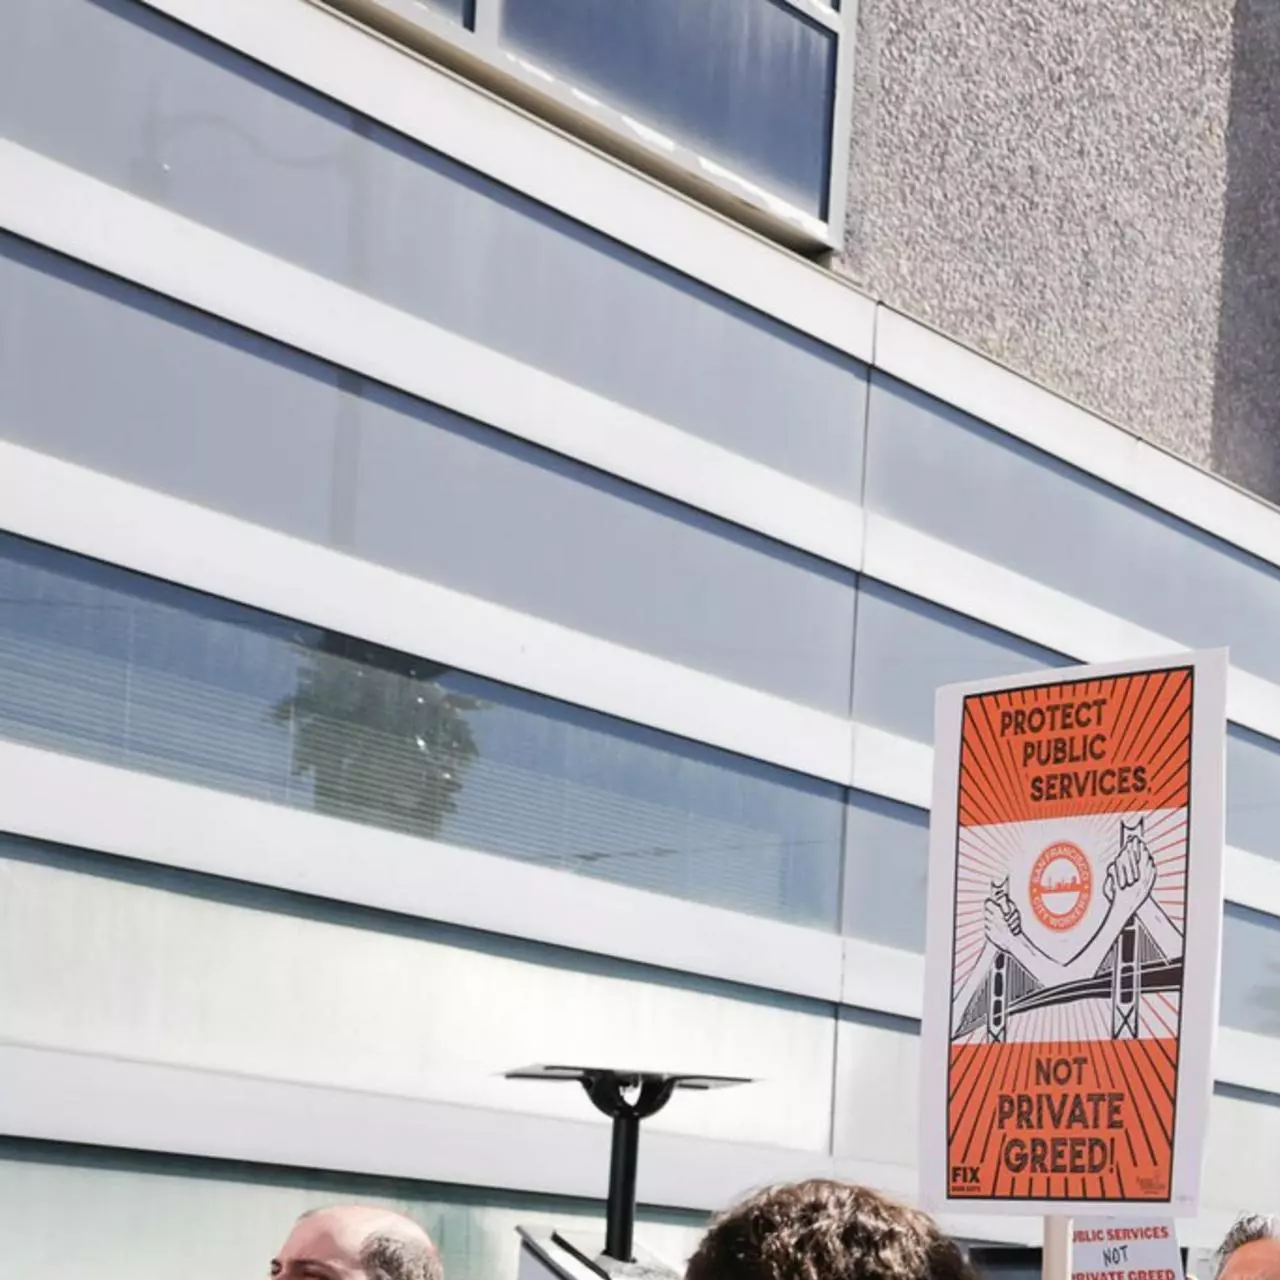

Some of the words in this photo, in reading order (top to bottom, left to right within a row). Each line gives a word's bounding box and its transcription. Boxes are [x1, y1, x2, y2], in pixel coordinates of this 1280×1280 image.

[1000, 699, 1107, 738] PROTECT
[1022, 734, 1107, 767] PUBLIC
[1034, 1057, 1088, 1086] NOT
[997, 1092, 1125, 1130] PRIVATE
[1003, 1137, 1116, 1174] GREED!
[952, 1166, 981, 1184] FIX
[1107, 1227, 1169, 1241] SERVICES
[1102, 1244, 1128, 1267] NOT
